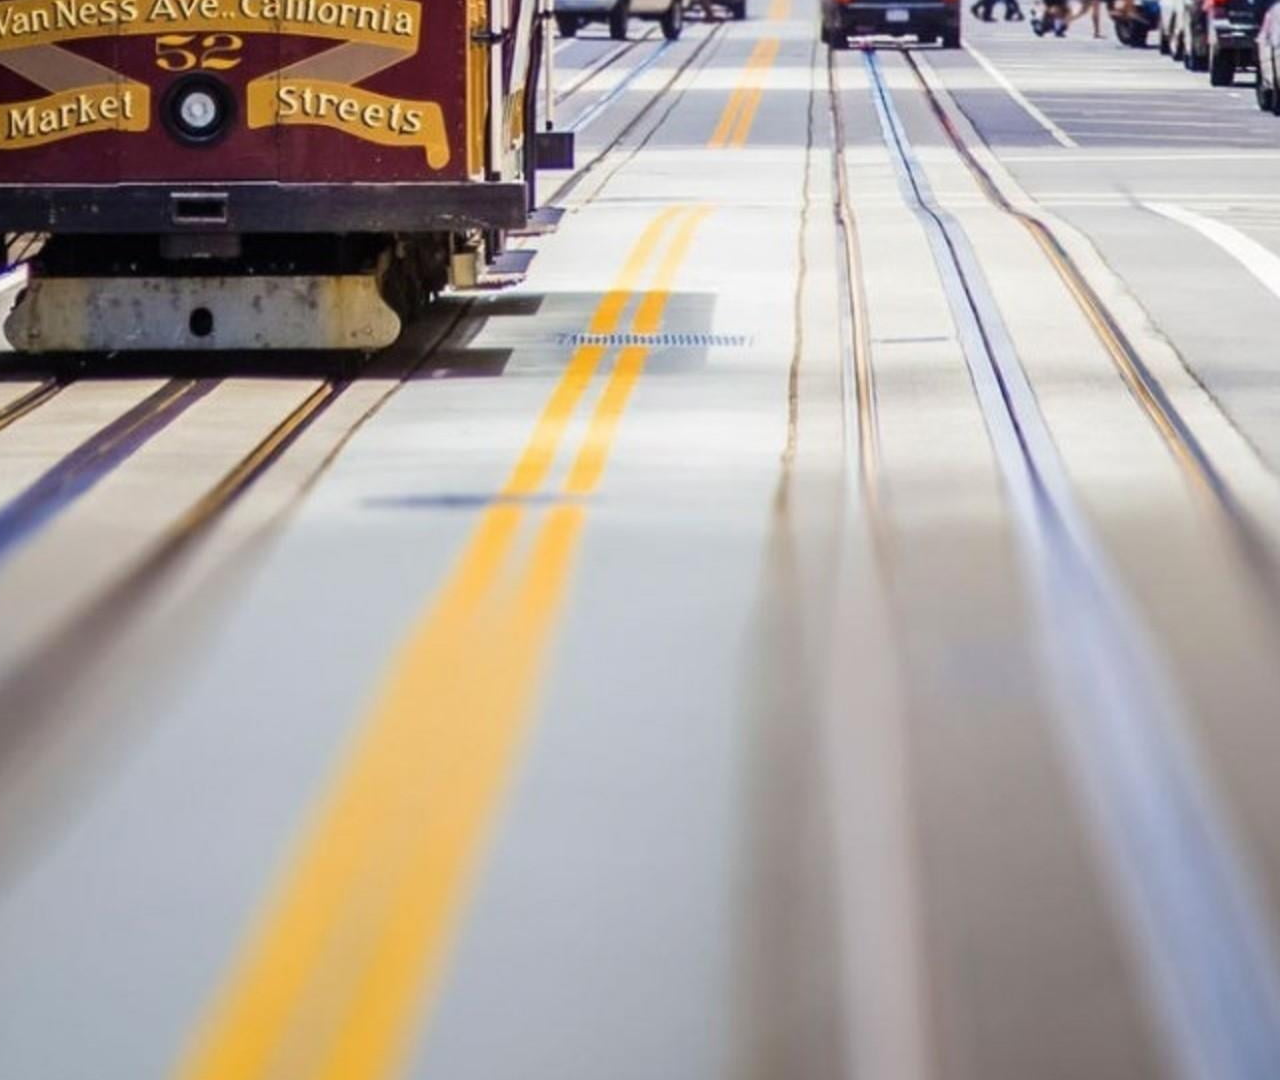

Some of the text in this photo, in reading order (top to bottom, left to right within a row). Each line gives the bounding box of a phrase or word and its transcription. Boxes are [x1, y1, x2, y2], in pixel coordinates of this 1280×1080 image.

[155, 34, 243, 71] 52
[8, 91, 134, 138] Market
[277, 86, 423, 135] Streets
